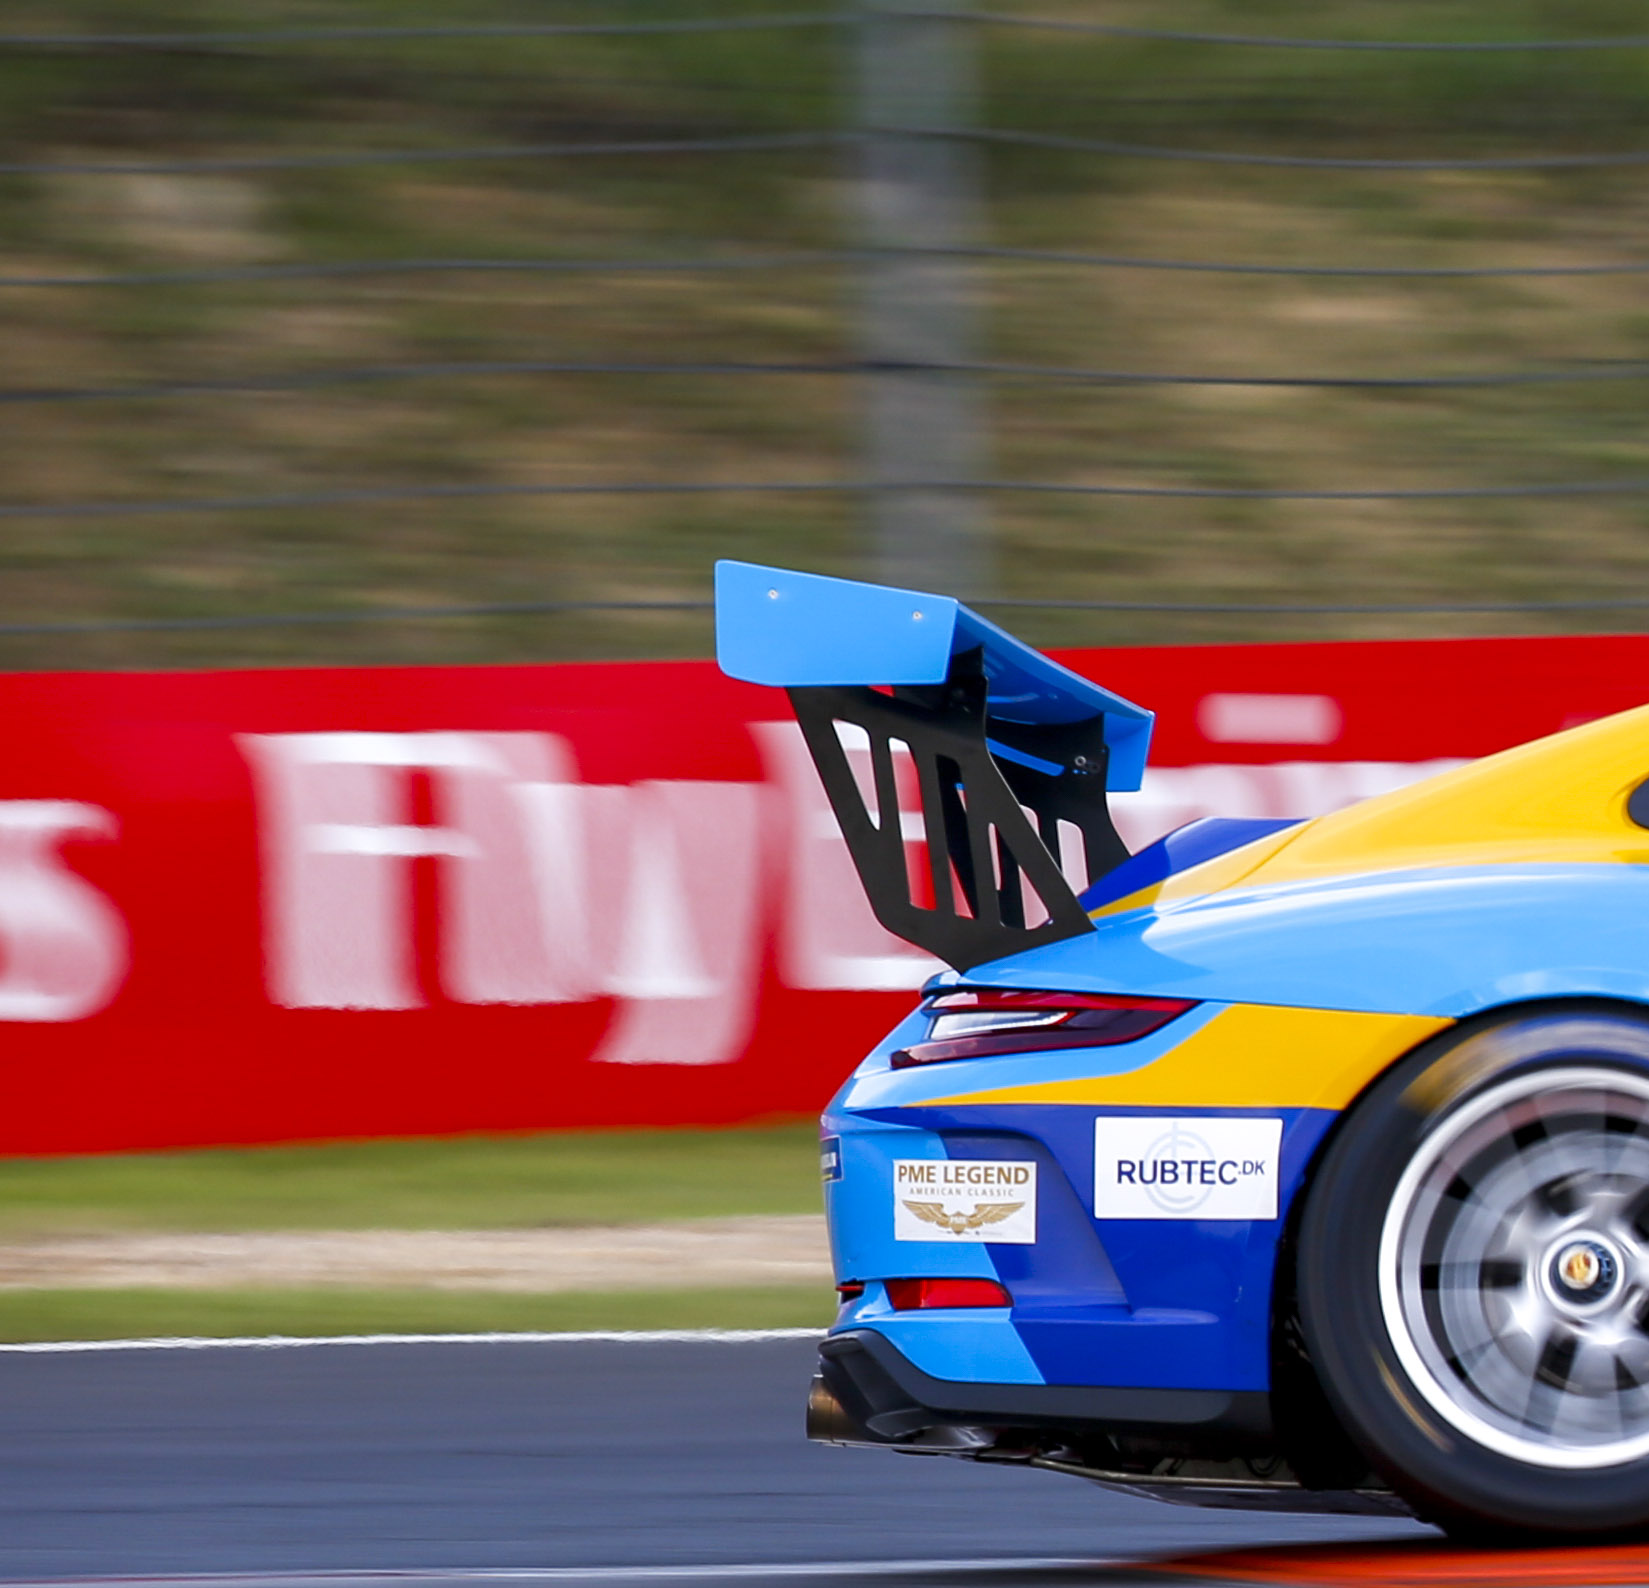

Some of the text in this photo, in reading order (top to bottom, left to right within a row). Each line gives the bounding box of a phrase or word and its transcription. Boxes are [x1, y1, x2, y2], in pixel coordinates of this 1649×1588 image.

[236, 730, 775, 1063] Fly
[898, 1164, 1030, 1185] PME LEGEND
[909, 1187, 1015, 1197] AMERICAN CLASSIC
